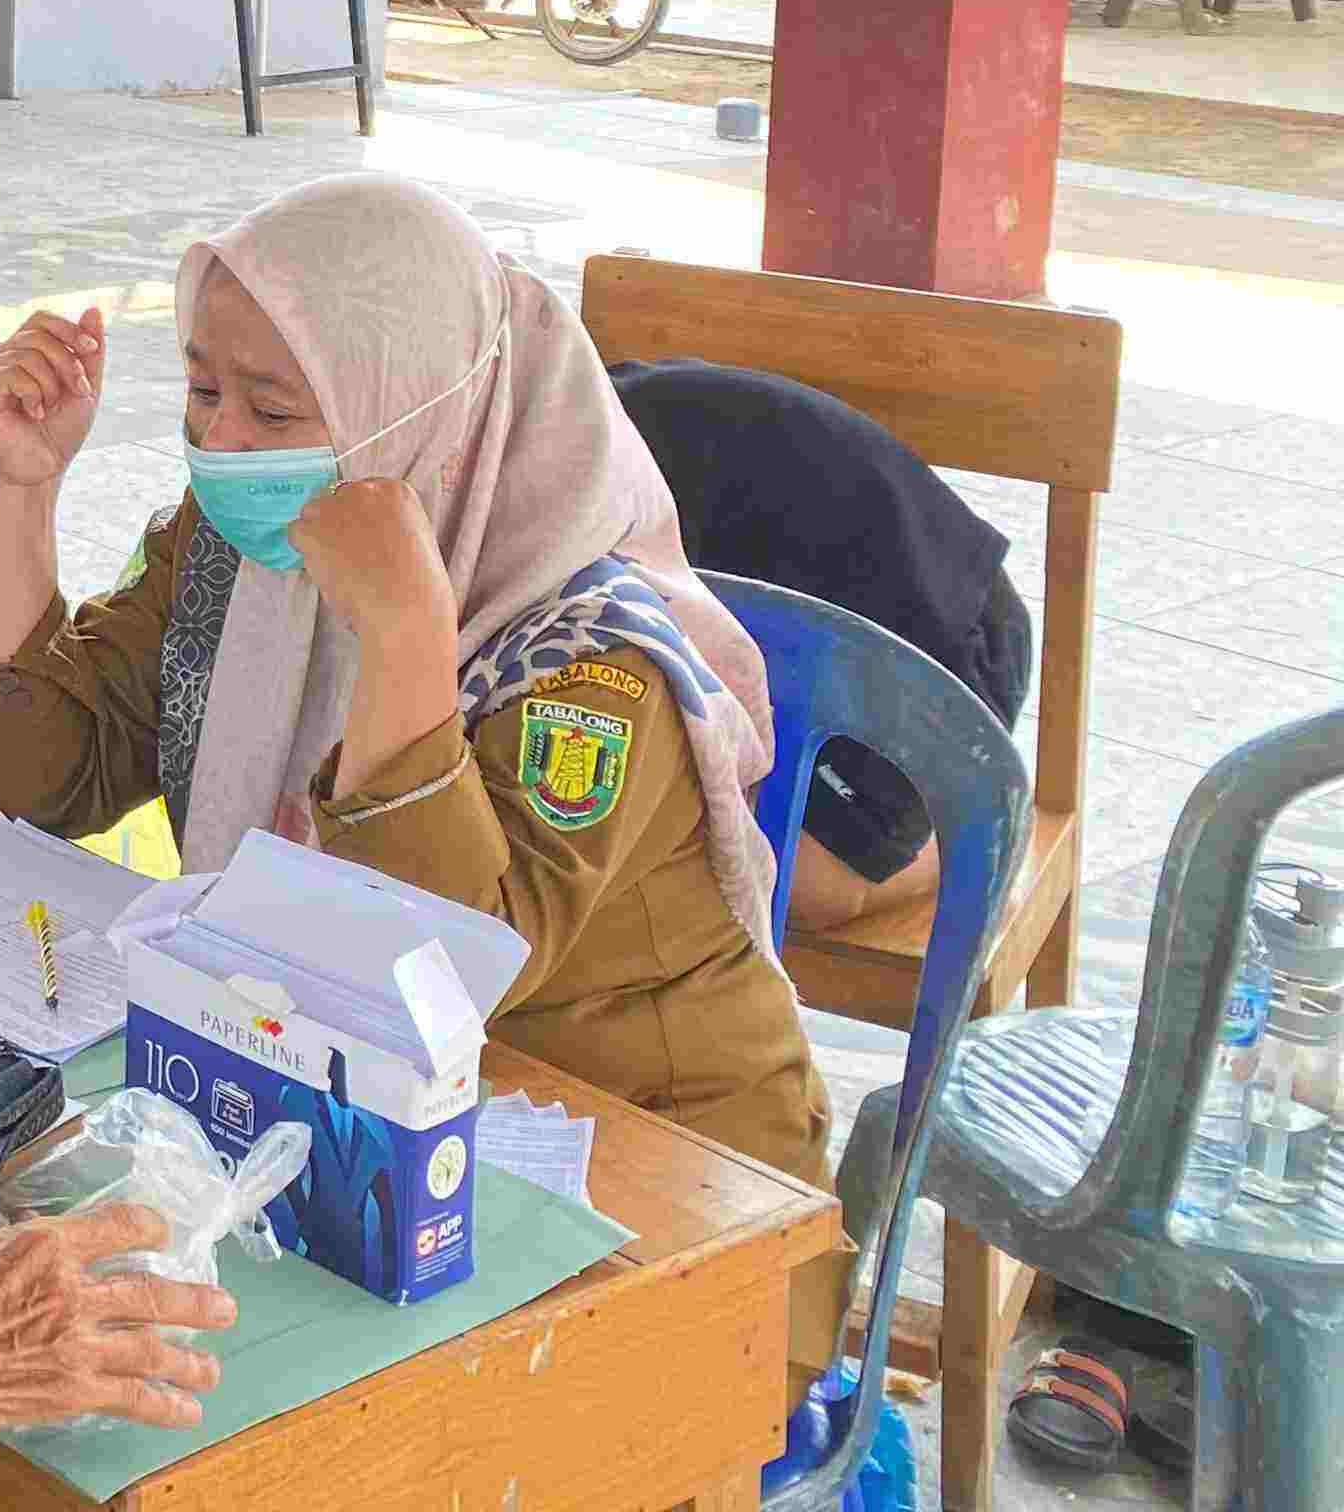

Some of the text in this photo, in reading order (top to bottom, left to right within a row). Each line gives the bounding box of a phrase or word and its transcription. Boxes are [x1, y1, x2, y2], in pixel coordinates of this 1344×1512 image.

[533, 704, 624, 735] TABALONG
[199, 1009, 306, 1072] PAPERLINE
[144, 1039, 200, 1103] 110
[438, 1213, 463, 1241] APP
